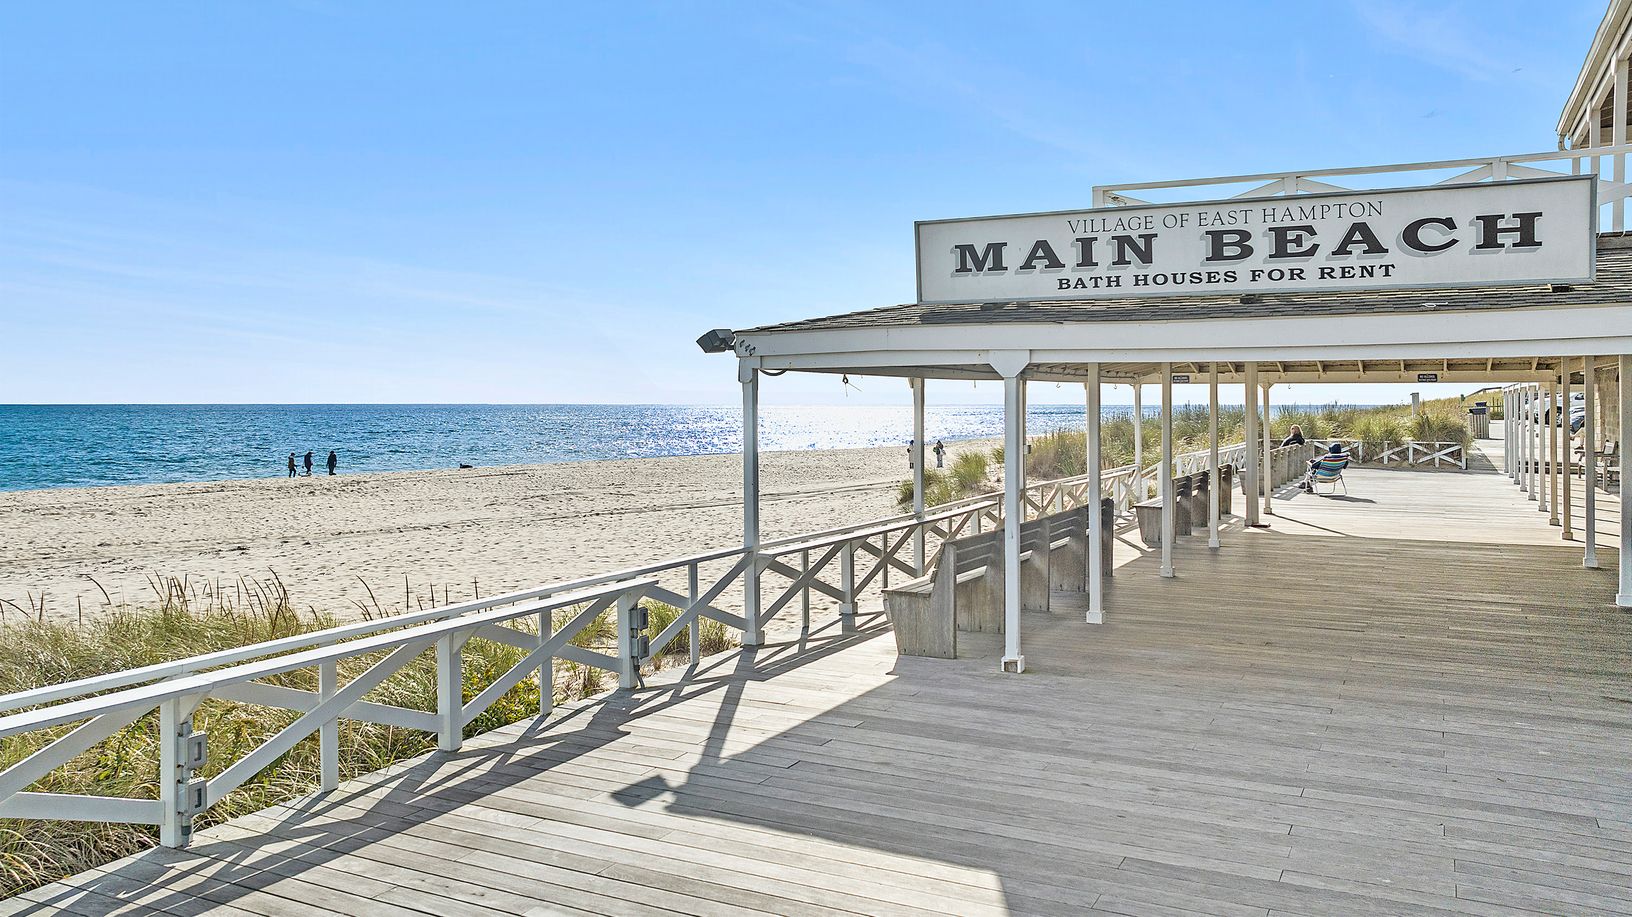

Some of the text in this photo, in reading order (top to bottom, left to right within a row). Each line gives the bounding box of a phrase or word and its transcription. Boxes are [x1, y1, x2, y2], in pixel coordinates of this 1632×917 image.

[1067, 201, 1382, 233] VILLAGE OF EAST HAMPTON
[953, 211, 1543, 274] MAIN BEACH
[1057, 264, 1395, 290] BATH HOUSES FOR RENT
